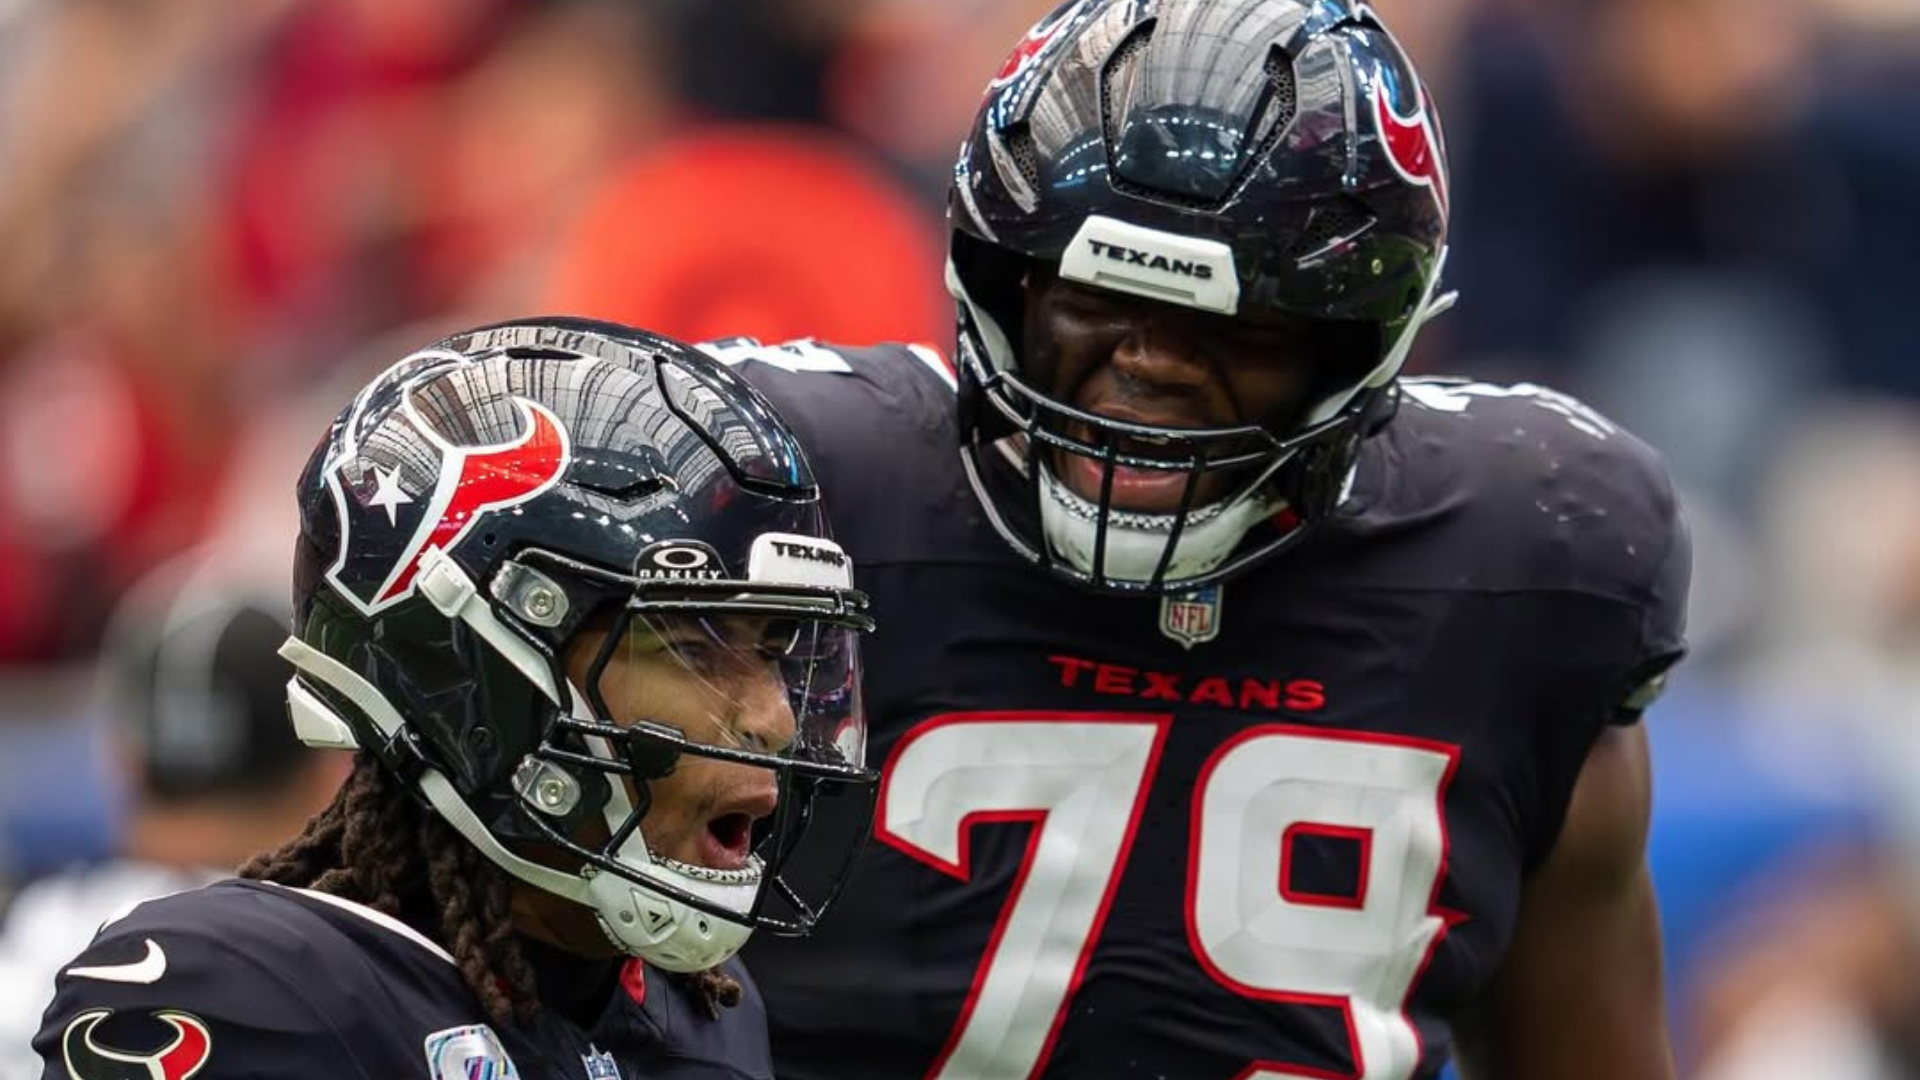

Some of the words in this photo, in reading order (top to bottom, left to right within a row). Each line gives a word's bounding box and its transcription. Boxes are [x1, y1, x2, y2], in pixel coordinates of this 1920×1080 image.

[1087, 238, 1213, 280] TEXANS
[770, 541, 846, 568] TEXANS
[639, 568, 722, 580] OAKLEY
[1170, 603, 1210, 631] NFL
[1048, 655, 1326, 711] TEXANS
[873, 710, 1472, 1080] 79
